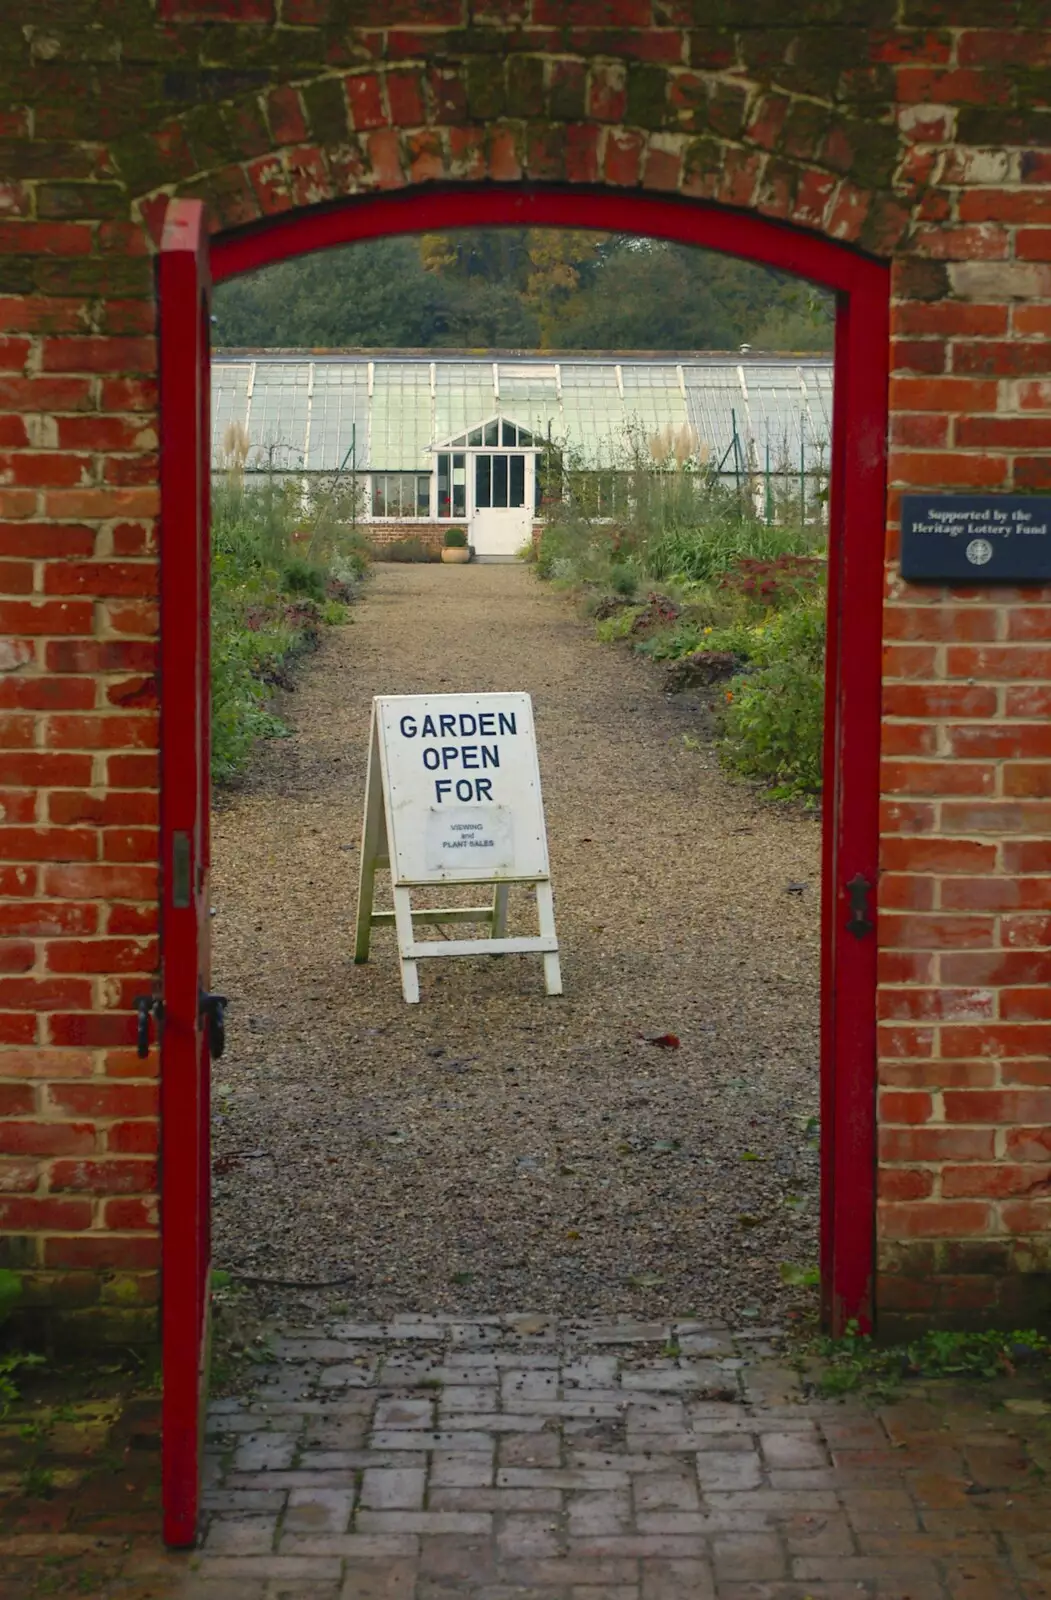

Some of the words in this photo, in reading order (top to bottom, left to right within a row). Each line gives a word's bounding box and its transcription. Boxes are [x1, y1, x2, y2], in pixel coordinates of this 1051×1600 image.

[928, 509, 990, 523] Supported
[993, 510, 1008, 524] by
[1012, 510, 1032, 521] the
[912, 522, 964, 536] Heritage
[968, 523, 1012, 537] Lottery
[1016, 524, 1048, 535] Fund
[400, 712, 517, 738] GARDEN
[423, 745, 500, 770] OPEN
[435, 778, 494, 803] FOR
[450, 823, 483, 831] VIEWING
[442, 840, 467, 848] PLANT
[469, 839, 494, 847] SALES
